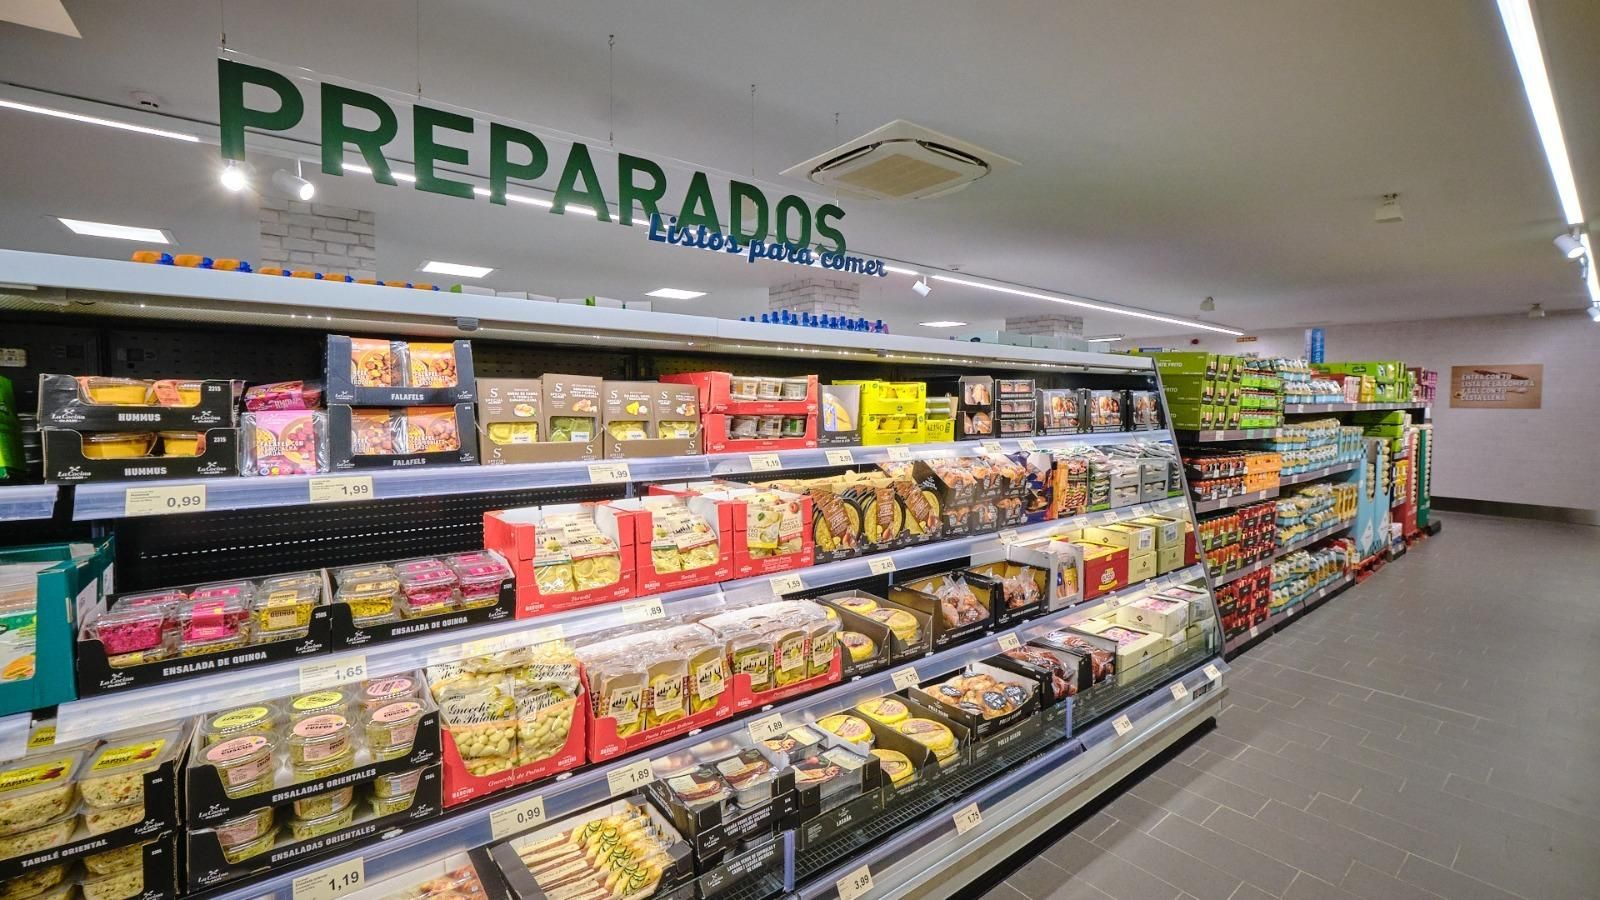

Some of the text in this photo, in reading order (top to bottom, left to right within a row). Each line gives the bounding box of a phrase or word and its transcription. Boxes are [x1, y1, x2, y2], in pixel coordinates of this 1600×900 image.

[218, 59, 846, 257] PREPARADOS
[648, 213, 888, 278] Listos para comer
[391, 393, 425, 401] FALAFELS
[118, 413, 161, 422] HUMMUS
[393, 458, 426, 467] FALAFELS
[124, 467, 168, 476] HUMMUS
[610, 470, 628, 479] 1,99
[341, 484, 369, 496] 1,99
[166, 495, 201, 508] 0,99
[391, 616, 468, 636] ENSALADA DE QUINOA
[162, 651, 268, 676] ENSALADA DE QUINOA
[335, 665, 363, 680] 1,65
[447, 702, 490, 717] Gnocchi
[450, 716, 461, 724] de
[767, 721, 784, 733] 1,89
[488, 775, 516, 788] Gnocchi
[516, 772, 525, 780] de
[630, 768, 650, 784] 1,89
[271, 767, 377, 803] ENSALADAS ORIENTALES
[517, 806, 541, 824] 0,99
[967, 813, 980, 823] 1,75
[61, 838, 109, 858] ORIENTAL
[271, 824, 376, 863] ENSALADAS ORIENTALES
[328, 871, 359, 891] 1,19
[855, 875, 870, 890] 3,99
